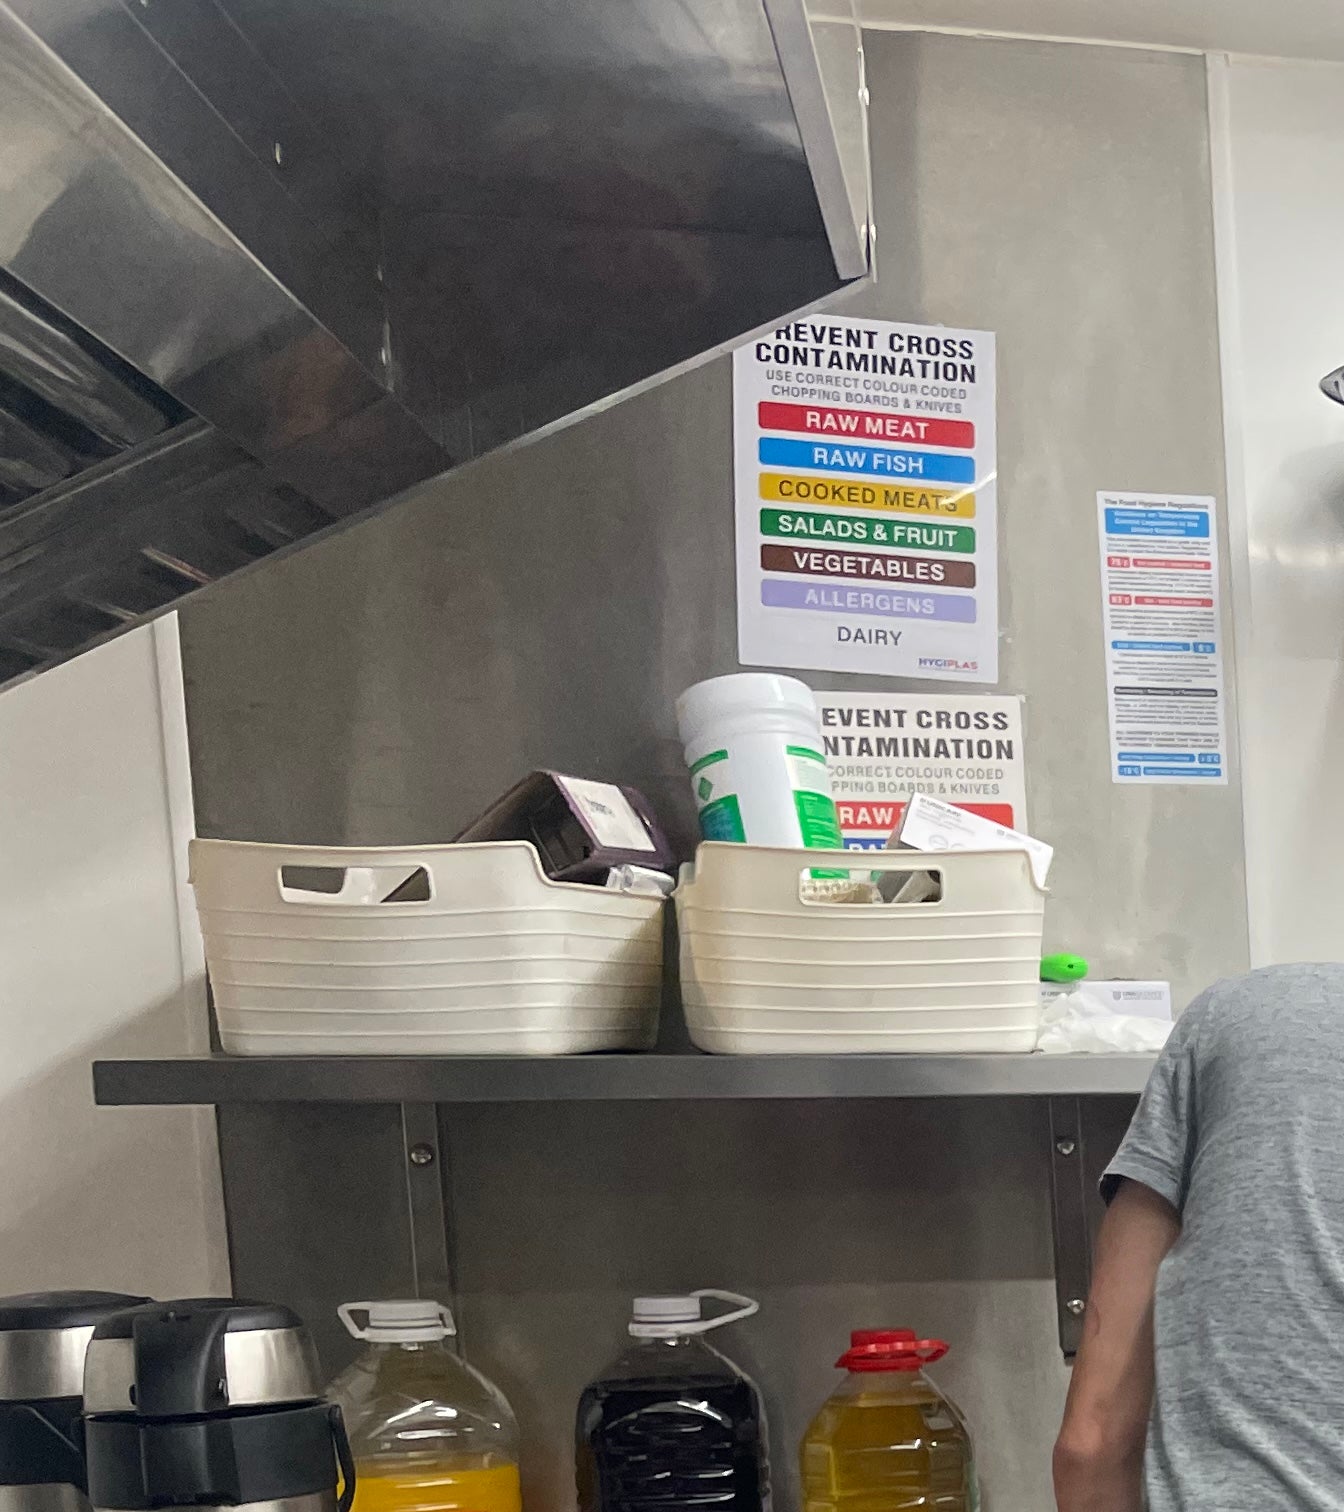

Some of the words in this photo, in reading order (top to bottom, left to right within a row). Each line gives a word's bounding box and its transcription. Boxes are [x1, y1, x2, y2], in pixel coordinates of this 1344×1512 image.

[775, 323, 878, 350] REVENT
[889, 333, 974, 360] CROSS
[756, 342, 976, 384] CONTAMINATION
[766, 369, 792, 382] USE
[796, 372, 859, 389] CORRECT
[863, 379, 918, 395] COLOUR
[920, 384, 967, 400] CODED
[771, 384, 841, 402] CHOPPING
[845, 391, 899, 409] BOARDS
[903, 398, 911, 409] &
[915, 399, 962, 414] KNIVES
[806, 411, 860, 433] RAW
[865, 417, 930, 440] MEAT
[813, 447, 866, 470] RAW
[872, 453, 924, 474] FISH
[779, 480, 876, 504] COOKED
[884, 489, 958, 512] MEATS
[778, 514, 868, 539] SALADS
[872, 524, 888, 542] &
[893, 525, 958, 547] FRUIT
[794, 552, 946, 581] VEGETABLES
[804, 588, 936, 614] ALLERGENS
[837, 626, 903, 646] DAIRY
[822, 707, 907, 728] EVENT
[916, 709, 1009, 731] CROSS
[823, 735, 1015, 760] NTAMINATION
[895, 765, 953, 780] COLOUR
[956, 767, 1003, 780] CODED
[832, 780, 875, 794] PPING
[950, 782, 1000, 796] KNIVES
[839, 806, 893, 825] RAW
